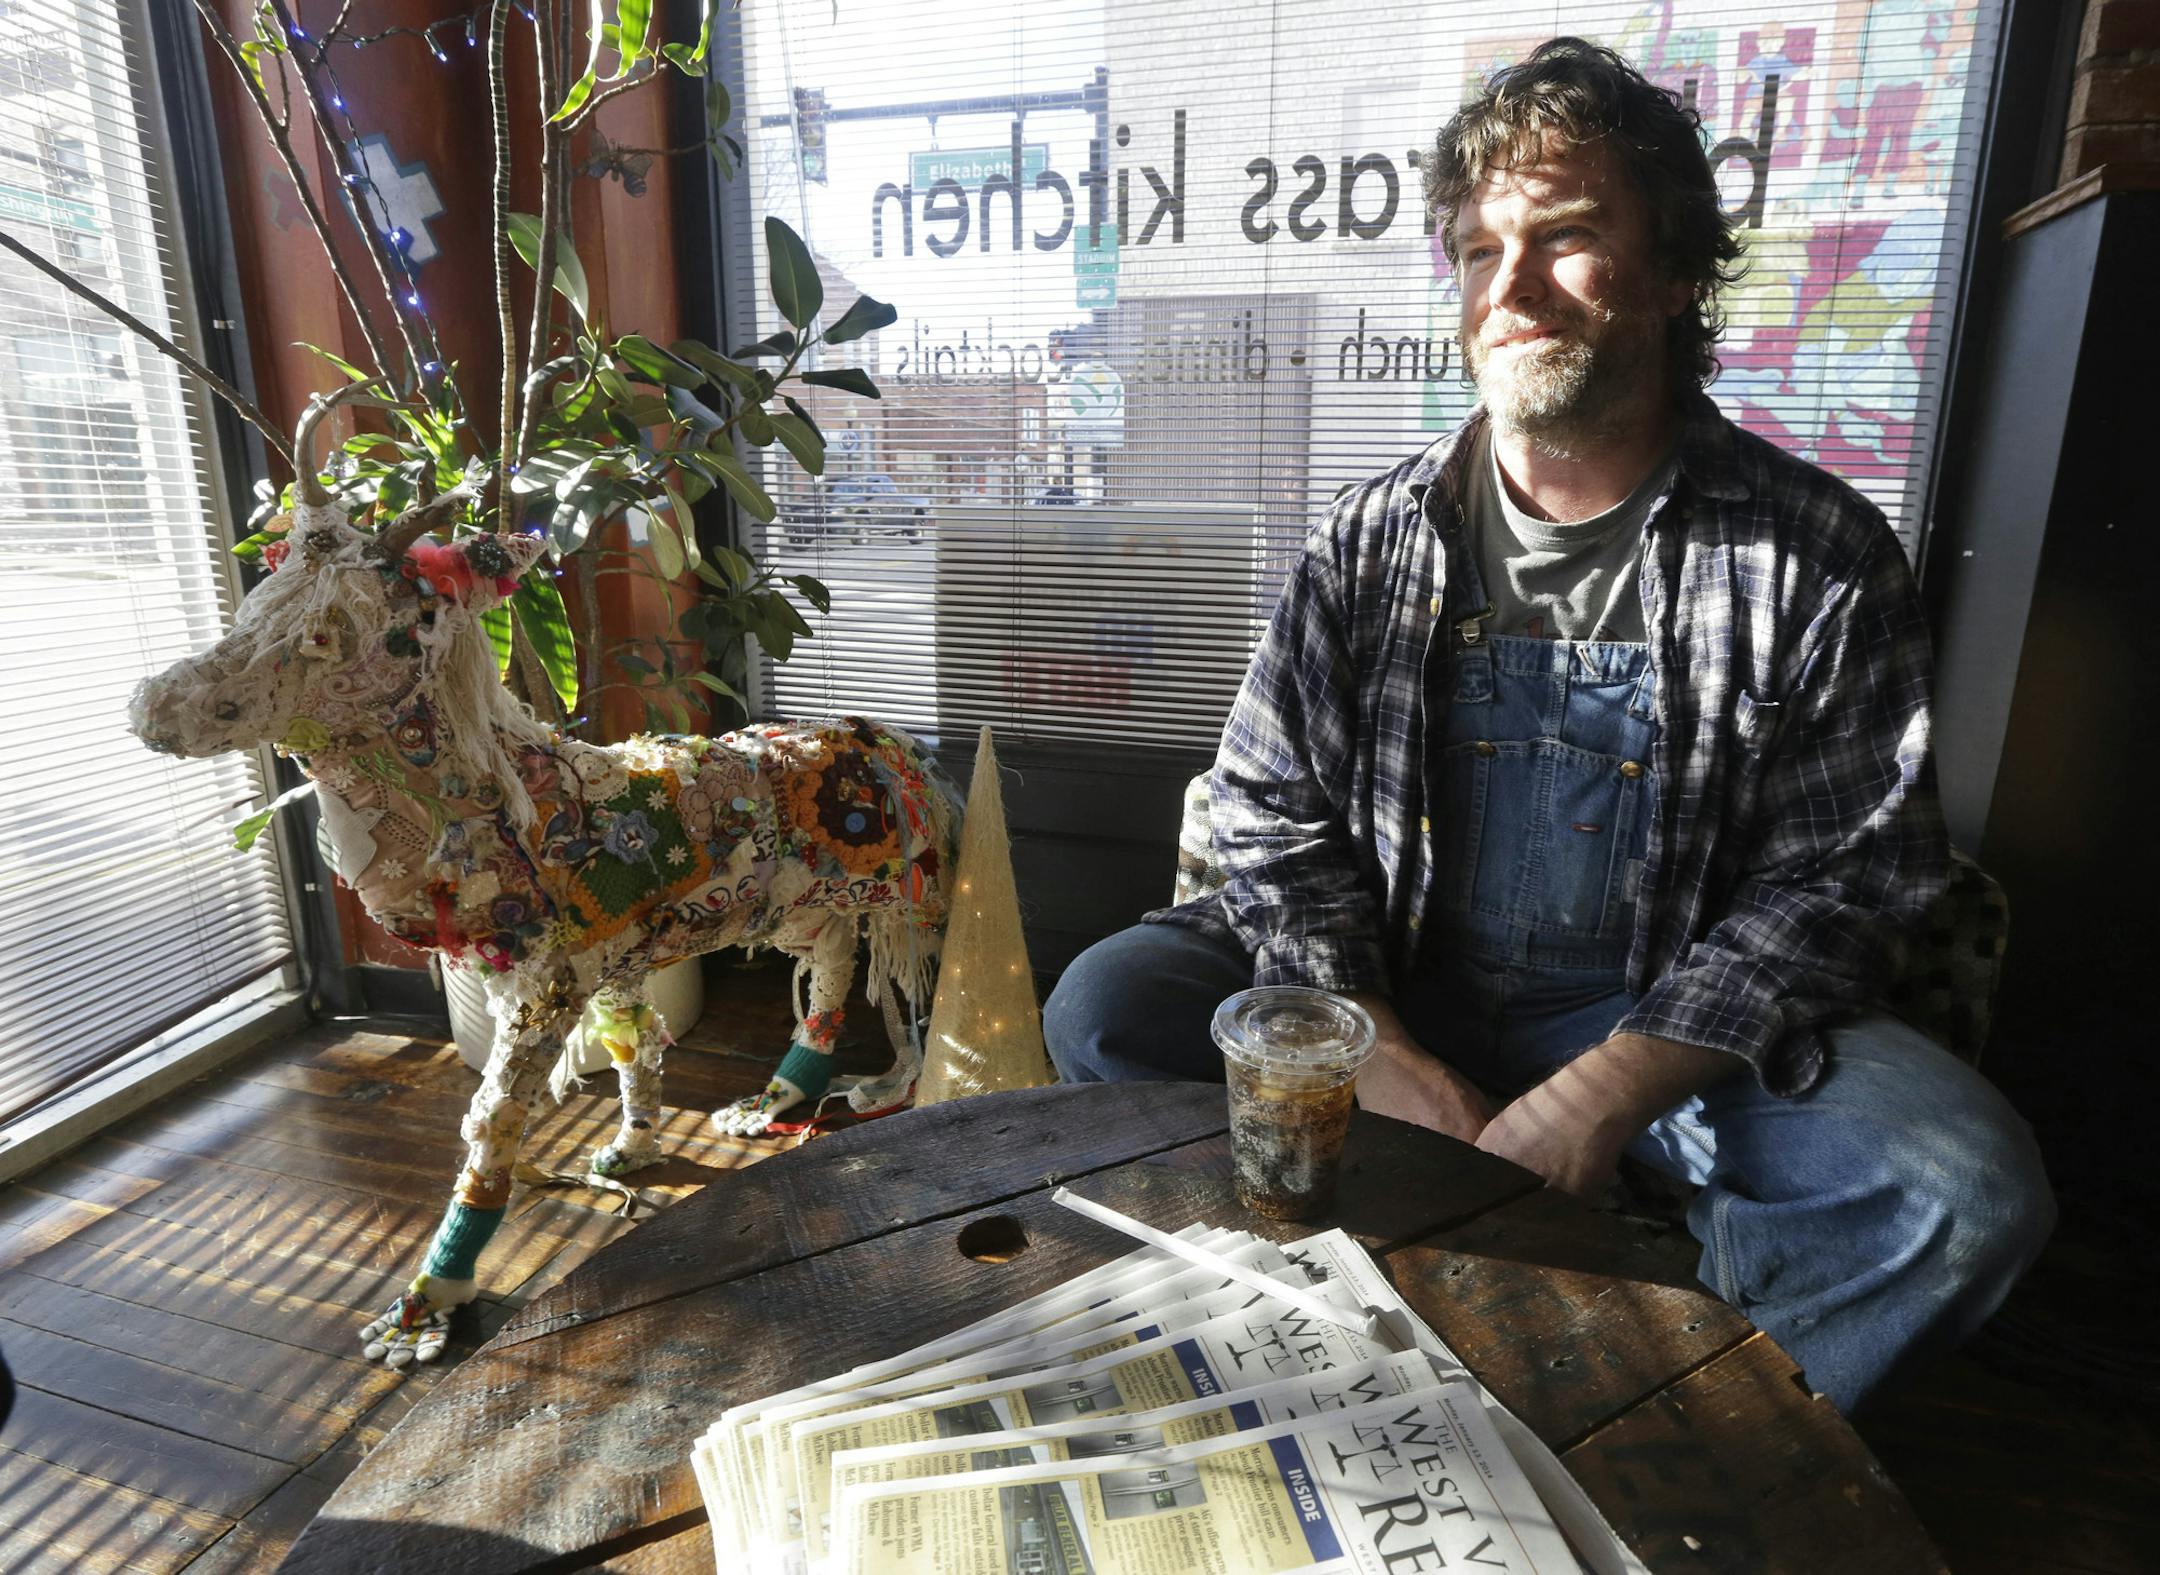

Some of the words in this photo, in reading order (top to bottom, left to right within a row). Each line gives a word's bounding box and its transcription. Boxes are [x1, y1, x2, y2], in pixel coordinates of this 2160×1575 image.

[1434, 1423, 1459, 1454] THE
[1456, 1421, 1475, 1452] January
[1479, 1460, 1494, 1480] 2014
[1238, 1450, 1250, 1472] about
[1392, 1405, 1476, 1523] WEST
[983, 1488, 994, 1513] Dollar
[1245, 1470, 1263, 1501] Frontier
[1251, 1446, 1267, 1479] Morrisey
[1262, 1478, 1274, 1503] warns
[1270, 1502, 1293, 1546] consumers
[1287, 1468, 1322, 1523] INSIDE
[895, 1498, 907, 1536] president
[909, 1495, 921, 1523] Former
[968, 1489, 979, 1526] customer
[1257, 1502, 1271, 1519] bill
[910, 1526, 923, 1552] WVMA
[971, 1527, 982, 1545] falls
[984, 1513, 998, 1546] General
[1174, 1514, 1188, 1539] price
[1263, 1517, 1278, 1539] scam
[1057, 1524, 1083, 1568] GENERAL
[1206, 1523, 1219, 1547] office
[1214, 1547, 1227, 1574] warns
